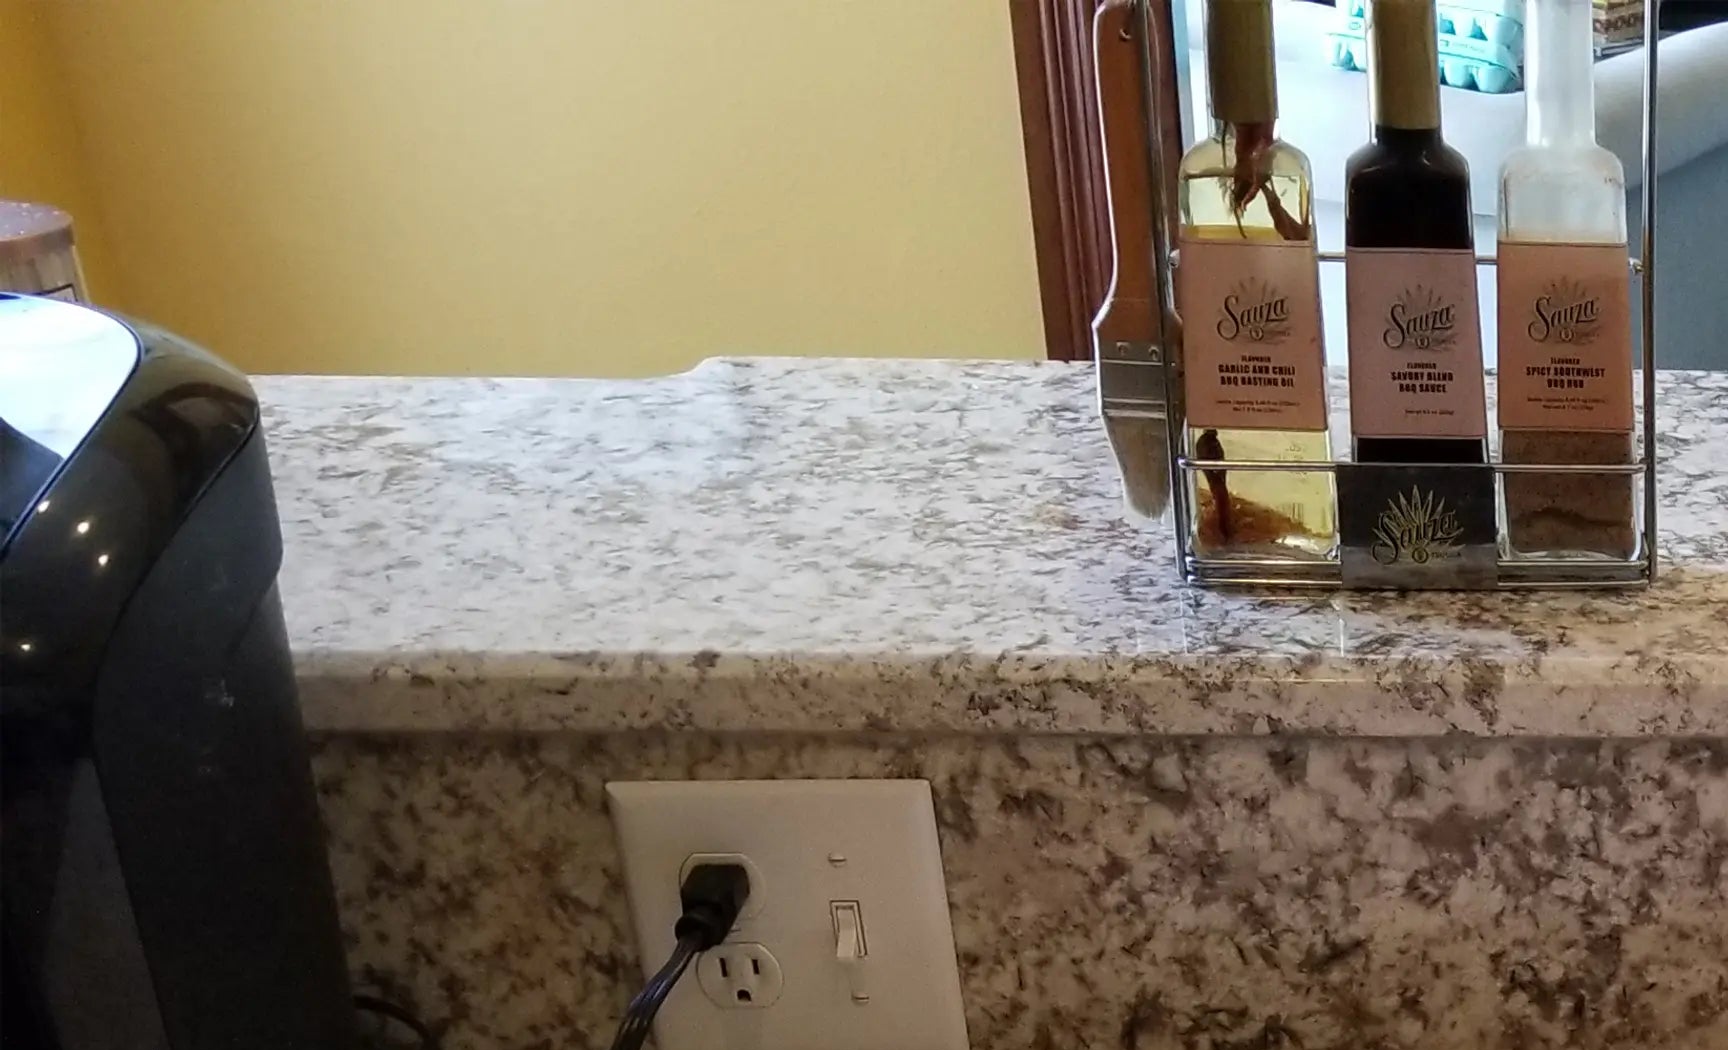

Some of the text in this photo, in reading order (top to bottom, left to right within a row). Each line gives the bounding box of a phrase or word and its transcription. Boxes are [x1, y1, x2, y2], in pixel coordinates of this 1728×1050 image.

[1217, 295, 1289, 341] Sauza
[1528, 296, 1599, 342] Sauza
[1383, 303, 1455, 349] Sauza
[1218, 364, 1296, 376] GARLIC AND CHILI
[1391, 371, 1454, 381] SAVORY BLEND
[1526, 366, 1606, 378] SPICY SOUTHWEST
[1220, 376, 1295, 387] BBQ BASTING OIL
[1547, 379, 1565, 389] BBQ
[1399, 383, 1447, 394] BBQ SAUCE
[1371, 511, 1460, 566] Sauza
